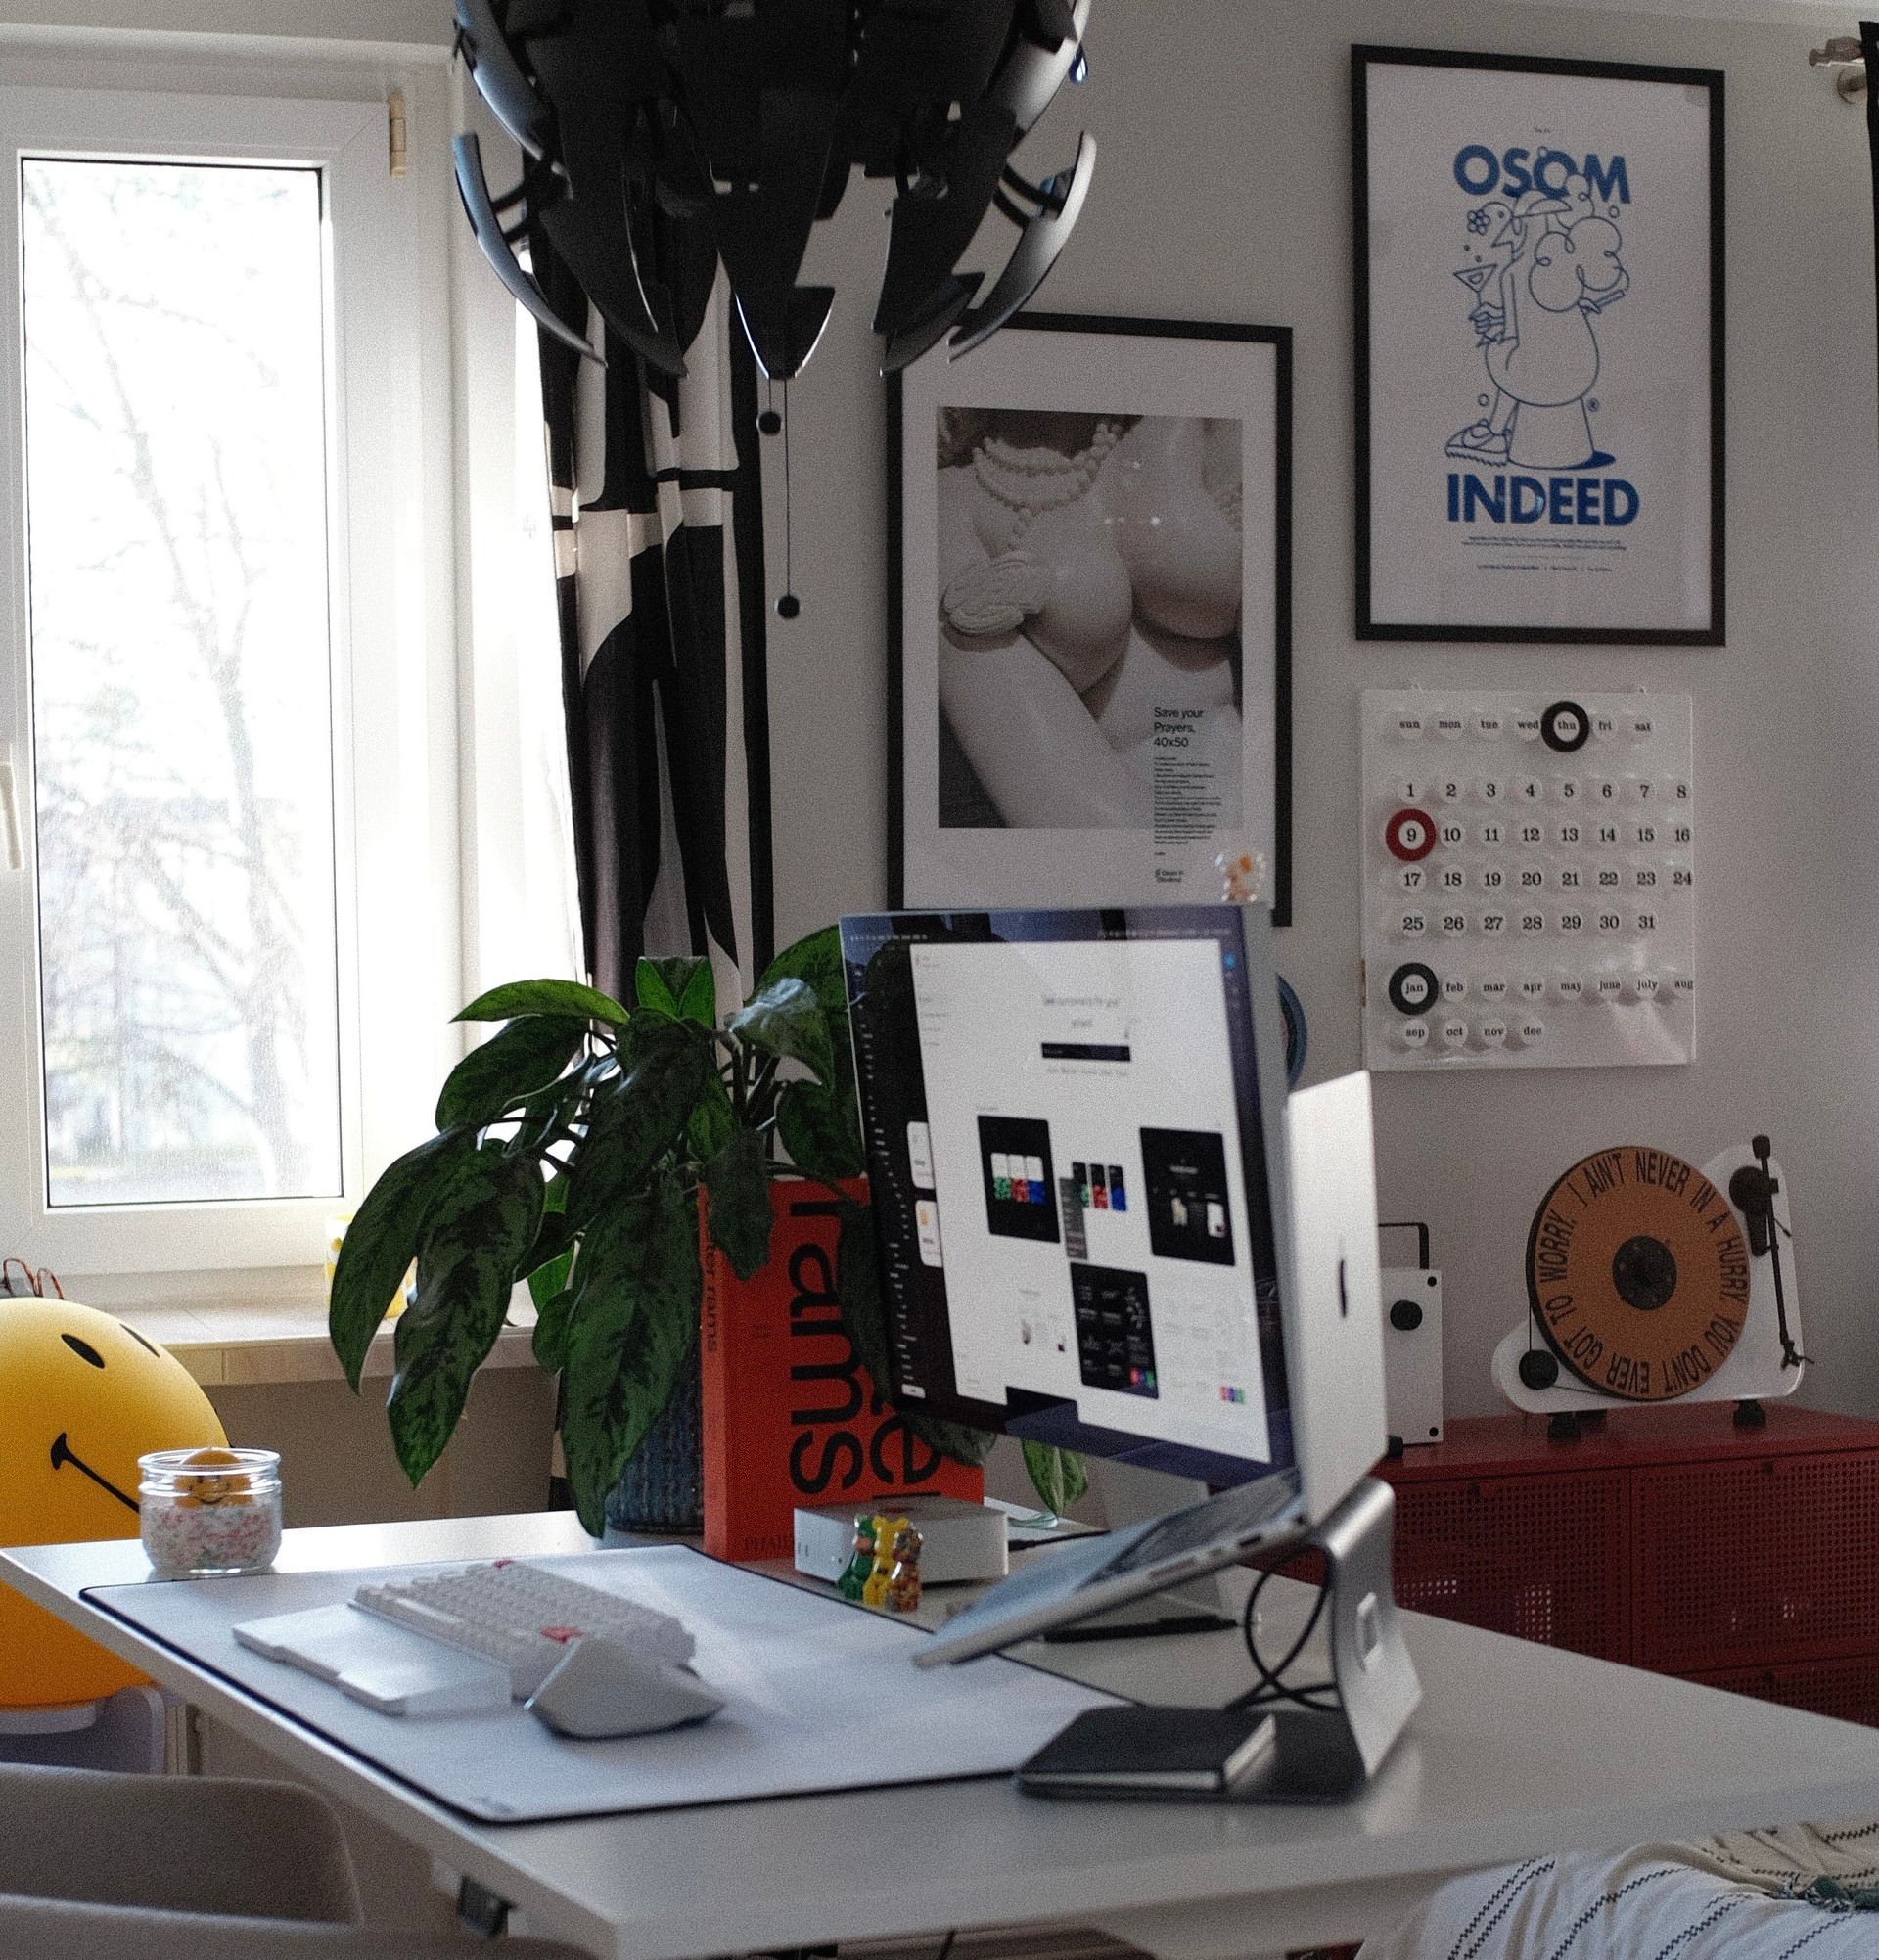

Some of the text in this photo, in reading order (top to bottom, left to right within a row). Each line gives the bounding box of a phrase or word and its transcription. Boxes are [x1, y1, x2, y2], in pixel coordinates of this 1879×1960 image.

[1453, 144, 1631, 204] OSOM
[1445, 474, 1640, 526] INDEED
[1154, 707, 1204, 721] Save your
[1398, 720, 1421, 729] sun
[1438, 720, 1462, 730] mon
[1480, 719, 1499, 730] tue
[1517, 719, 1539, 730] wed
[1557, 718, 1580, 730] thu
[1154, 737, 1189, 749] 40x50
[1407, 782, 1687, 798] 1 2 3 4 5 6 7 8
[1406, 827, 1691, 843] 9 10 11 12 13 14 15 16
[1403, 871, 1692, 887] 17 18 19 20 21 22 23 24
[1402, 915, 1655, 931] 25 26 27 28 29 30 31
[1405, 982, 1423, 993] jan
[1445, 981, 1464, 993] feb
[1483, 983, 1505, 992] mar
[1523, 983, 1543, 994] apr
[1560, 982, 1582, 993] may
[1405, 1028, 1426, 1040] sep
[1445, 1026, 1464, 1037] oct
[1484, 1028, 1504, 1037] nov
[1583, 1153, 1625, 1199] AIN'T
[1635, 1151, 1690, 1196] NEVER
[1569, 1182, 1587, 1208] I
[1690, 1182, 1717, 1213] IN
[1707, 1212, 1730, 1232] A
[1545, 1295, 1577, 1326] TO
[1704, 1313, 1739, 1356] YOU
[1565, 1327, 1605, 1369] GOT
[1606, 1353, 1650, 1394] EVER
[1665, 1345, 1711, 1392] DON'T
